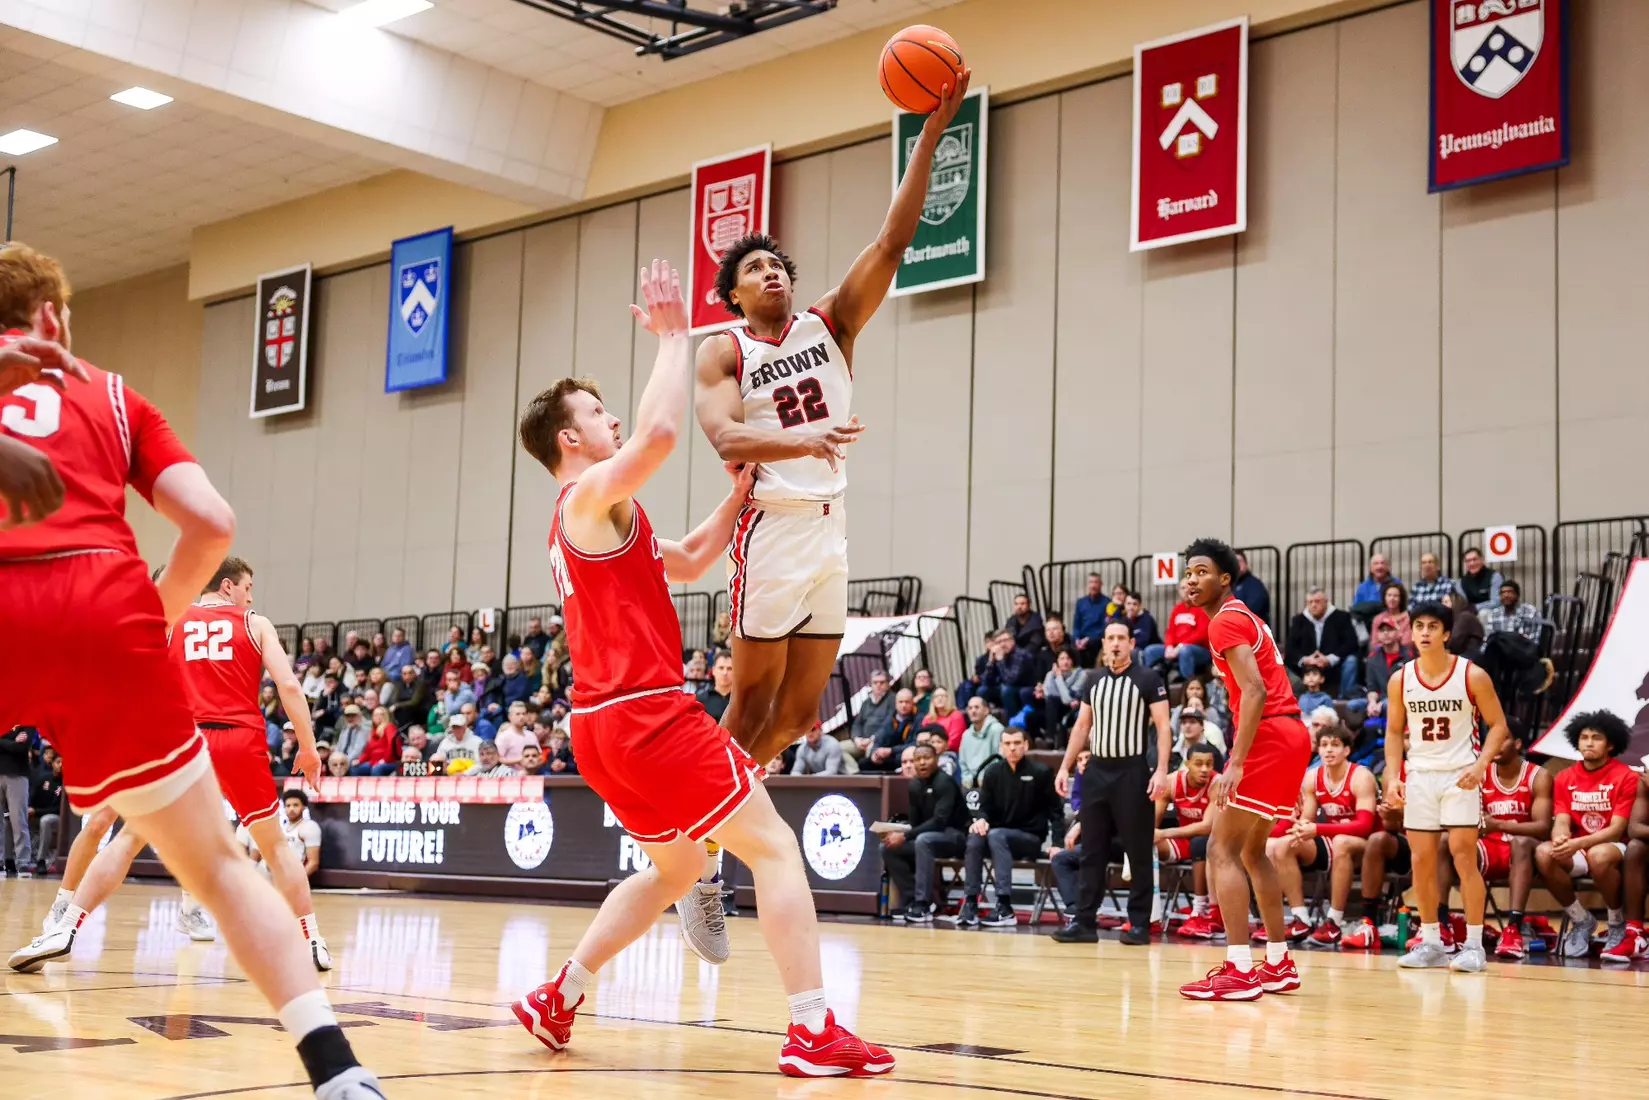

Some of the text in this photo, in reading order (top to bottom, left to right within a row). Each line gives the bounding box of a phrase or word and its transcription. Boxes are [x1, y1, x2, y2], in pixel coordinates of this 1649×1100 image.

[1439, 114, 1556, 160] Pennsylvania
[1157, 189, 1219, 221] Harvard
[904, 236, 970, 265] Dartmouth
[750, 342, 830, 389] BROWN
[772, 377, 830, 429] 22
[1490, 532, 1512, 555] O
[1157, 558, 1173, 579] N
[483, 612, 490, 627] L
[183, 620, 233, 661] 22
[1408, 700, 1463, 713] BROWN
[1422, 716, 1451, 741] 23
[402, 761, 428, 776] POSS
[349, 800, 460, 824] BUILDING YOUR
[361, 829, 444, 864] FUTURE!
